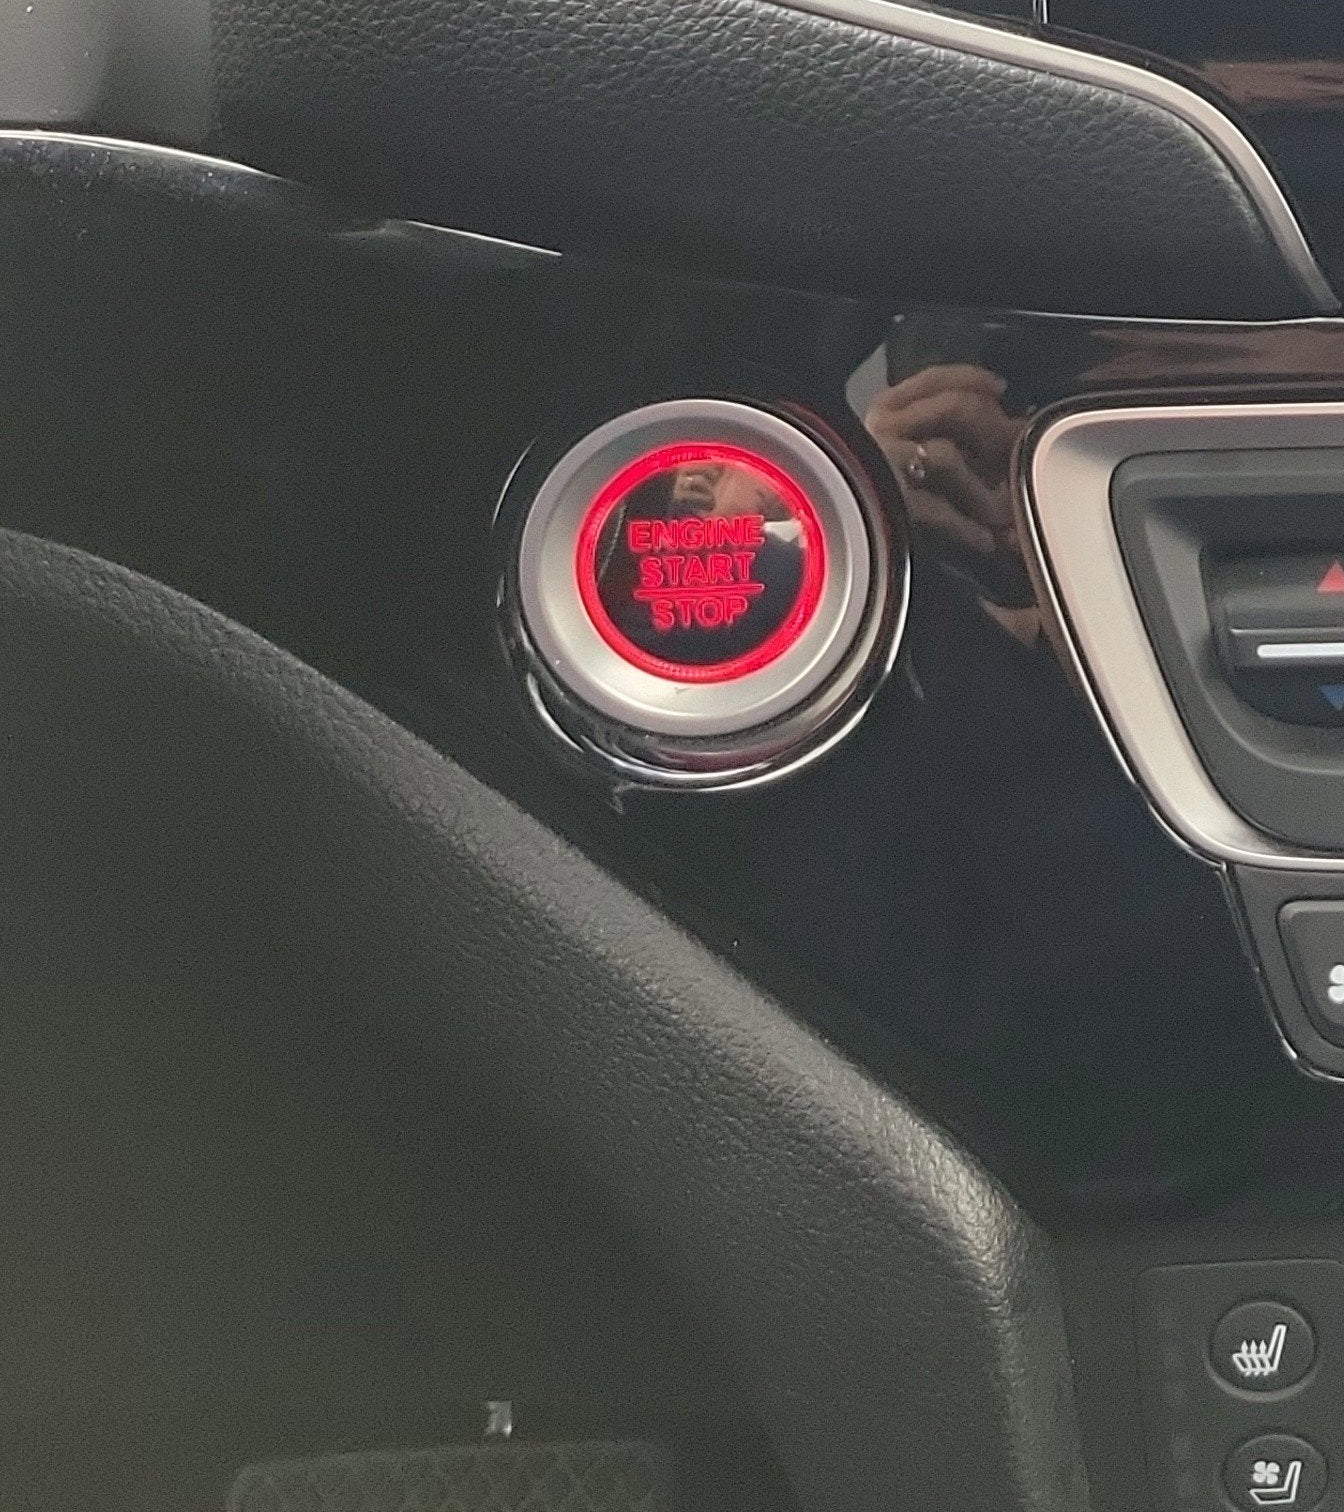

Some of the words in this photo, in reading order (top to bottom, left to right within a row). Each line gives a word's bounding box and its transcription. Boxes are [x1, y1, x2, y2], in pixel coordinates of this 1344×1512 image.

[627, 515, 766, 552] ENGINE
[639, 552, 756, 588] START
[652, 595, 748, 632] STOP
